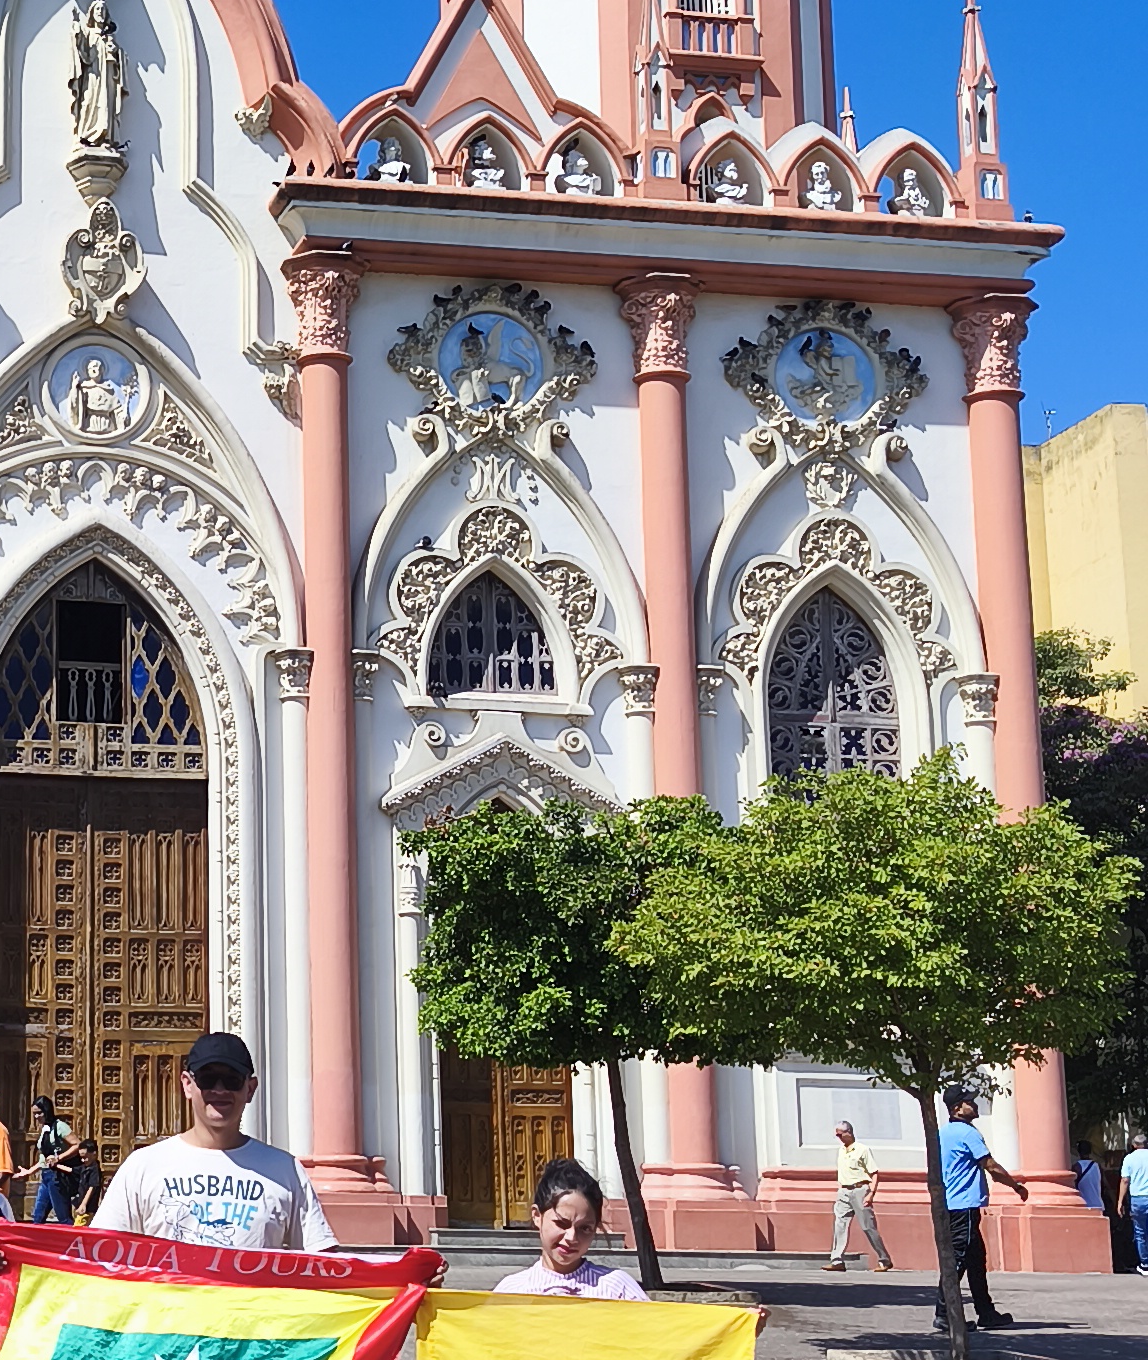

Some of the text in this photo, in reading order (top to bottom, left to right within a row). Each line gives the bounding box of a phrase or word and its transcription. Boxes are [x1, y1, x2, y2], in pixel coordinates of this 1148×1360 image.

[163, 1174, 264, 1201] HUSBAND
[221, 1201, 259, 1231] THE
[58, 1235, 353, 1278] AQUA TOURS
